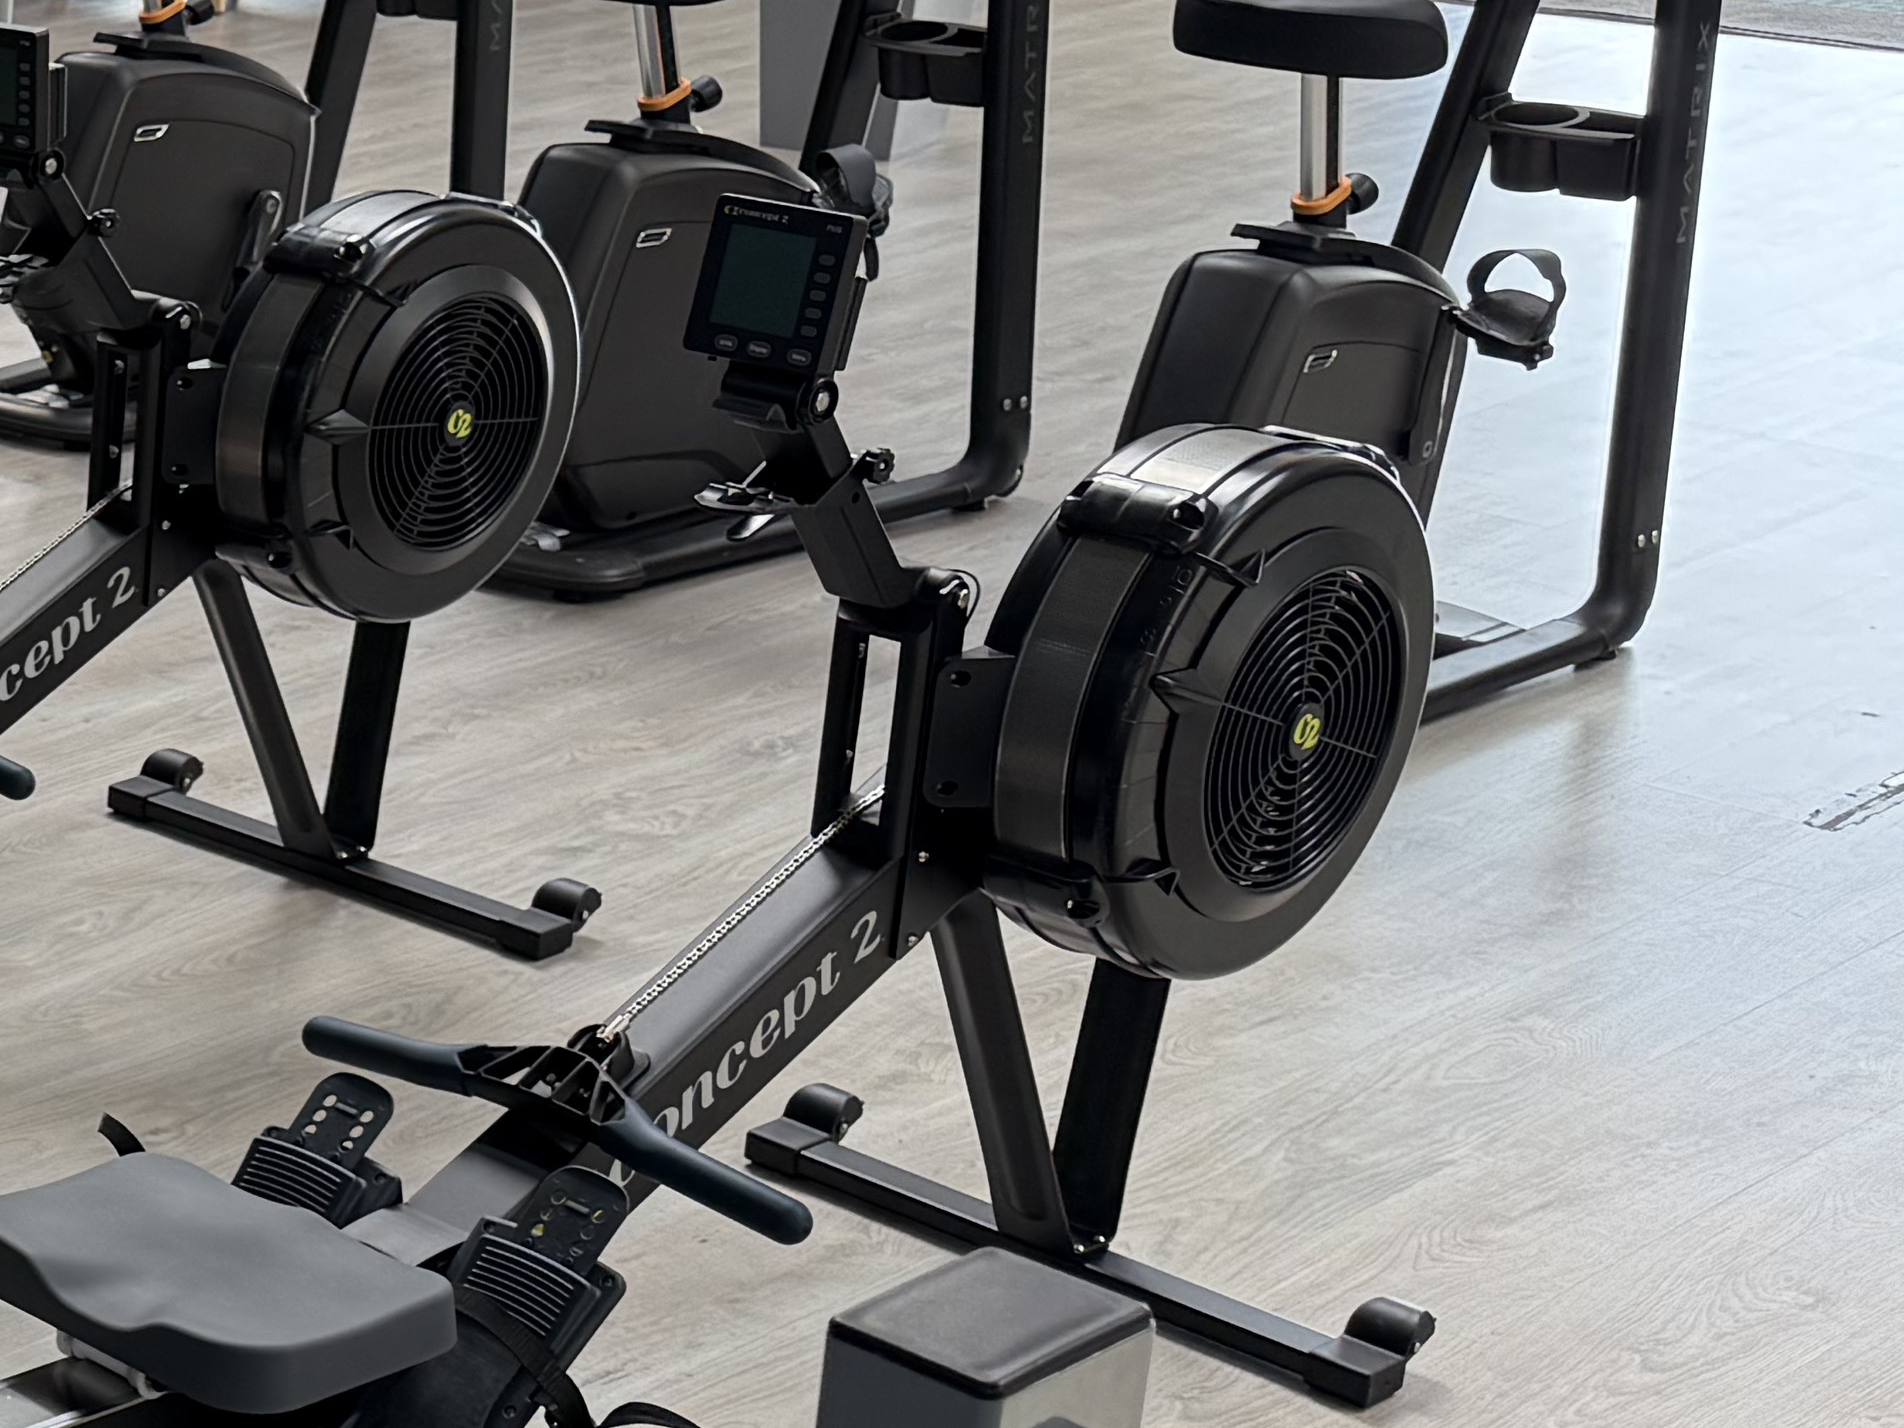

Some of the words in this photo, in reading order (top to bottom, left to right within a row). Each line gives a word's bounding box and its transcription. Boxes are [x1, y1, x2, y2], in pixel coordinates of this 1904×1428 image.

[1676, 20, 1712, 245] MATRIX
[107, 566, 135, 609] 2
[850, 910, 881, 964] 2
